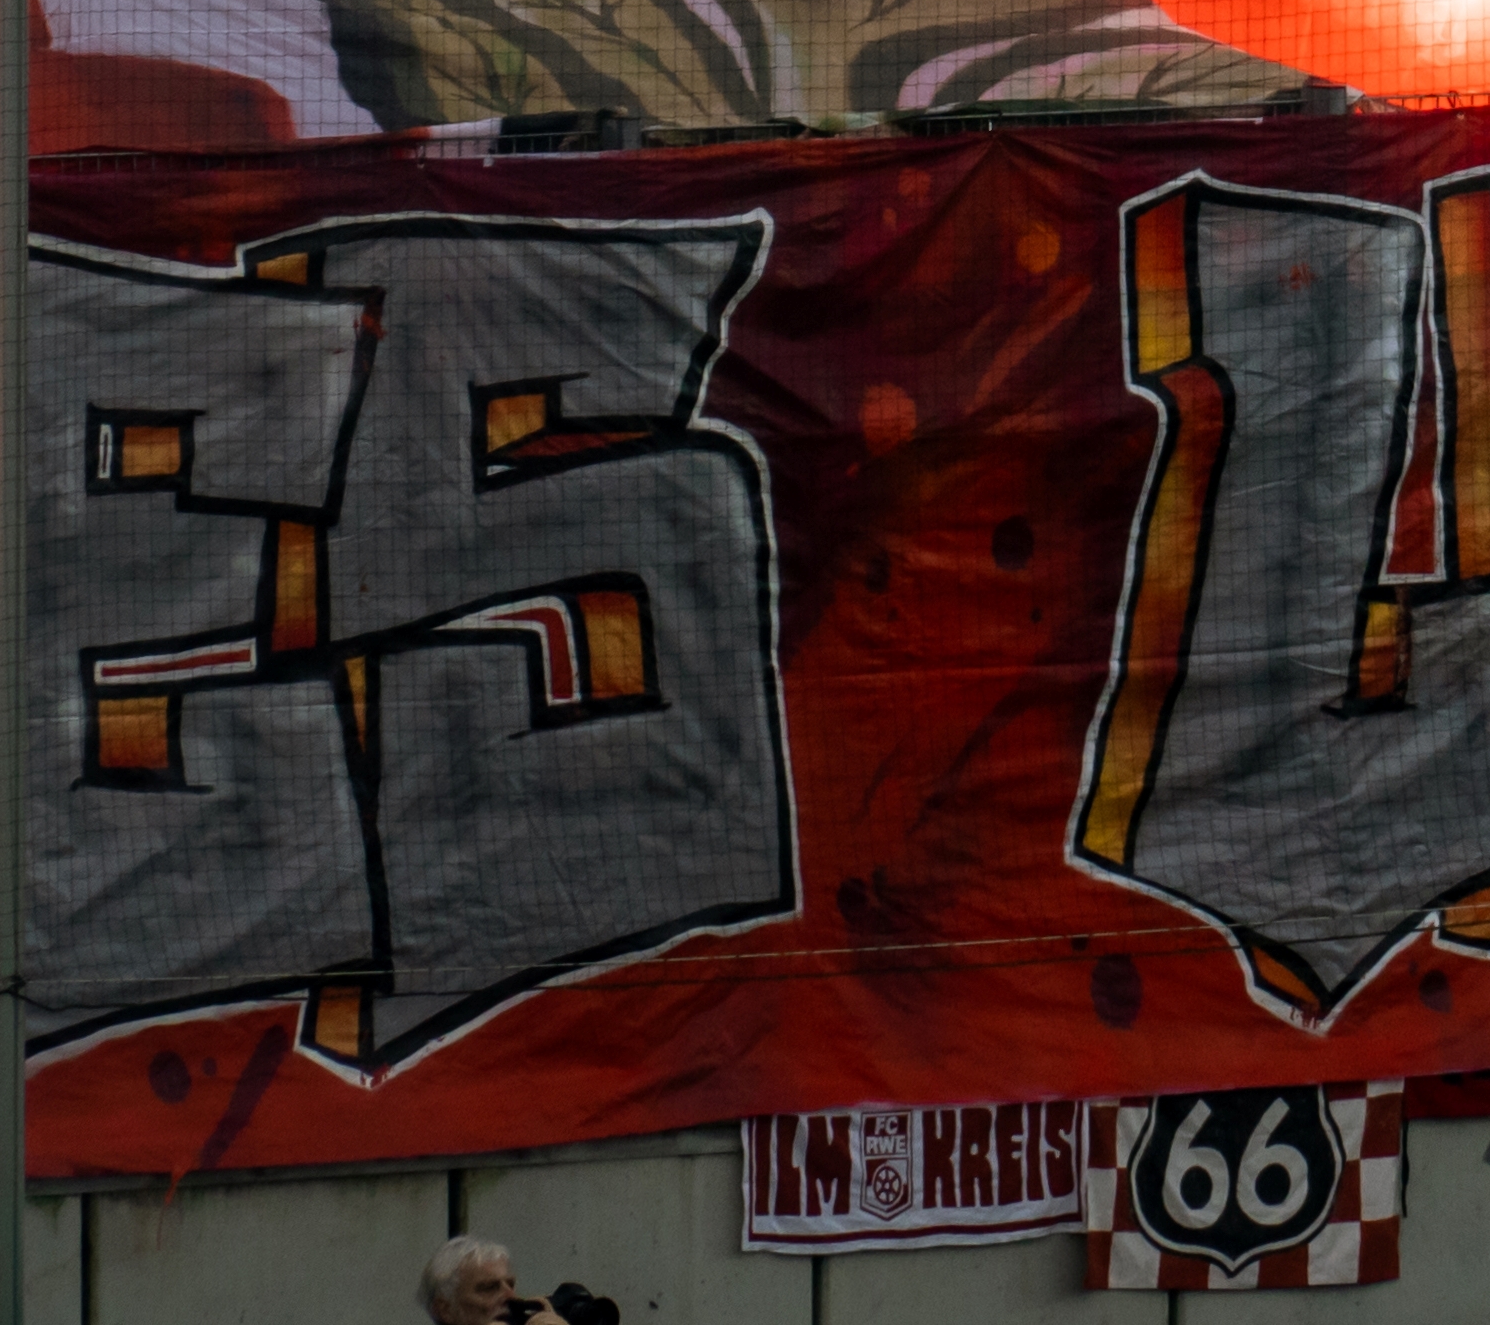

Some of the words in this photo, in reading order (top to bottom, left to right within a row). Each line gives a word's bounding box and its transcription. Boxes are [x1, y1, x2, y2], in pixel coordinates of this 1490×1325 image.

[755, 1113, 852, 1217] ILM
[922, 1101, 1079, 1210] KREIS
[865, 1136, 907, 1154] RWE
[873, 1117, 900, 1134] FC
[1163, 1097, 1309, 1229] 66
